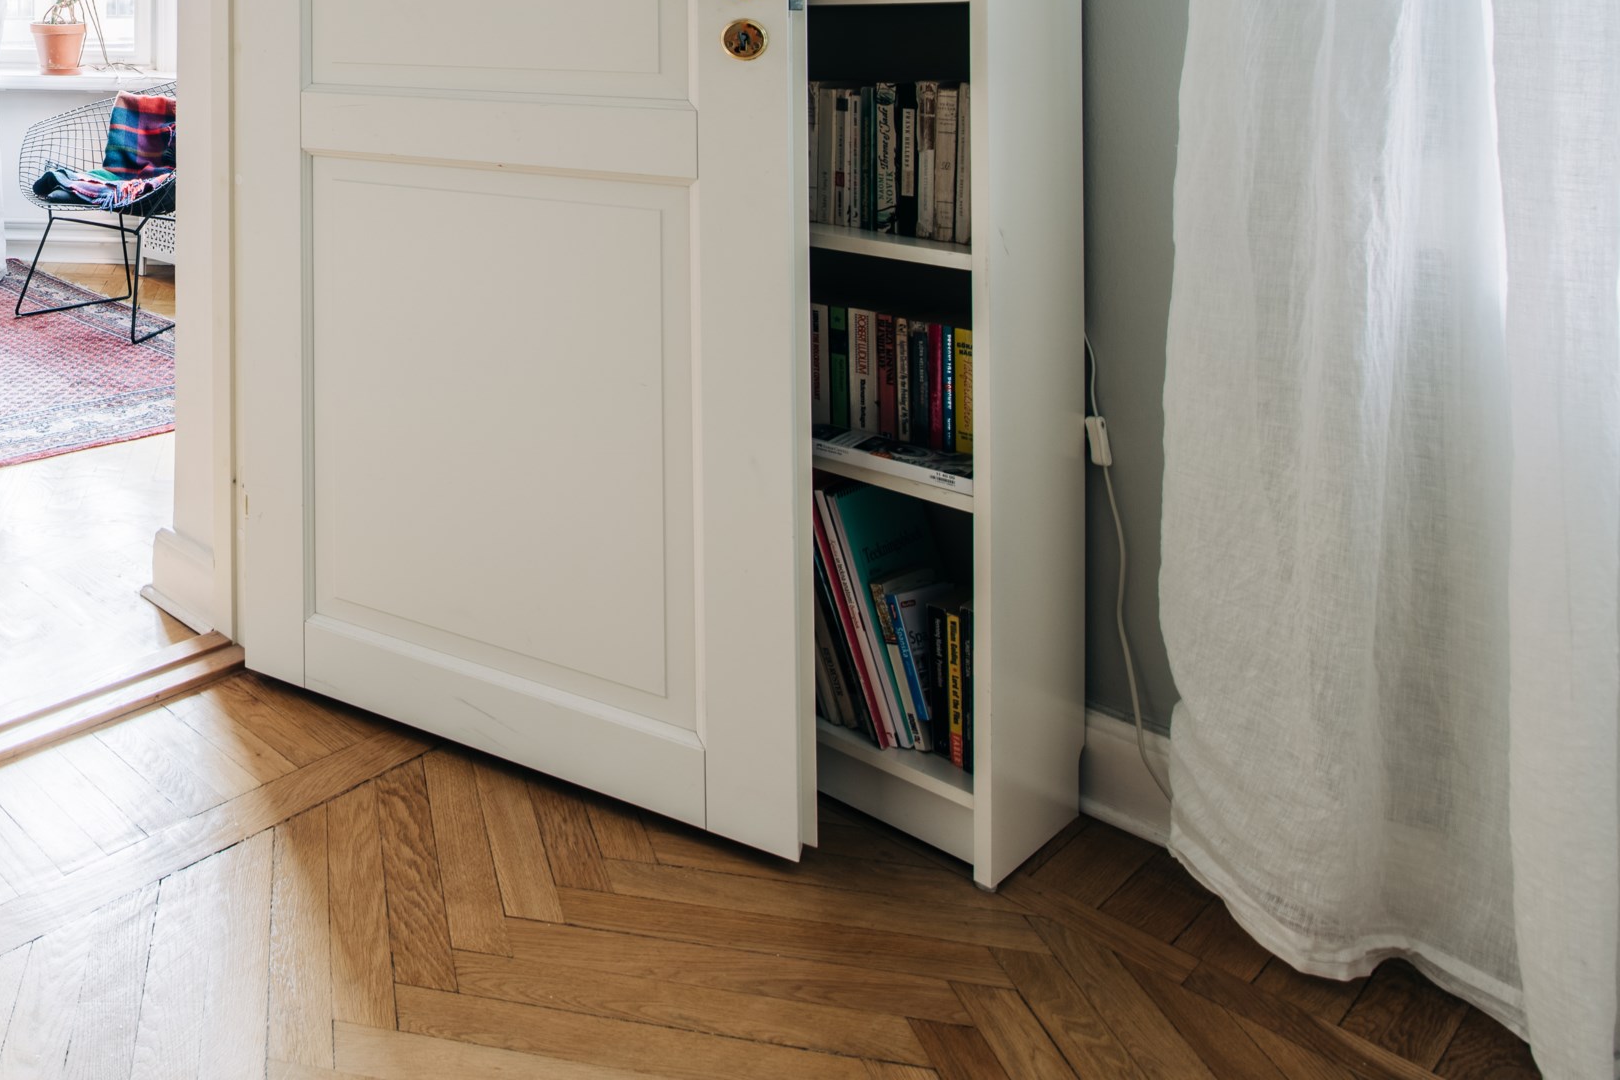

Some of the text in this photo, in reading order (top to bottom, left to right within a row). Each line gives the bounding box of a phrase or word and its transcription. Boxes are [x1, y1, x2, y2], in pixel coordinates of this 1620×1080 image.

[878, 107, 890, 133] Jade
[879, 140, 889, 170] Throne
[885, 170, 894, 204] NOVIK
[857, 314, 867, 342] ROBERT
[857, 342, 867, 375] LUDLUM
[840, 581, 852, 604] anatomi
[896, 627, 909, 658] Spanska
[949, 621, 958, 642] William
[950, 643, 959, 666] Golding
[951, 675, 960, 689] Lord
[952, 698, 960, 709] the
[952, 710, 960, 725] Flies
[953, 735, 961, 763] FABER
